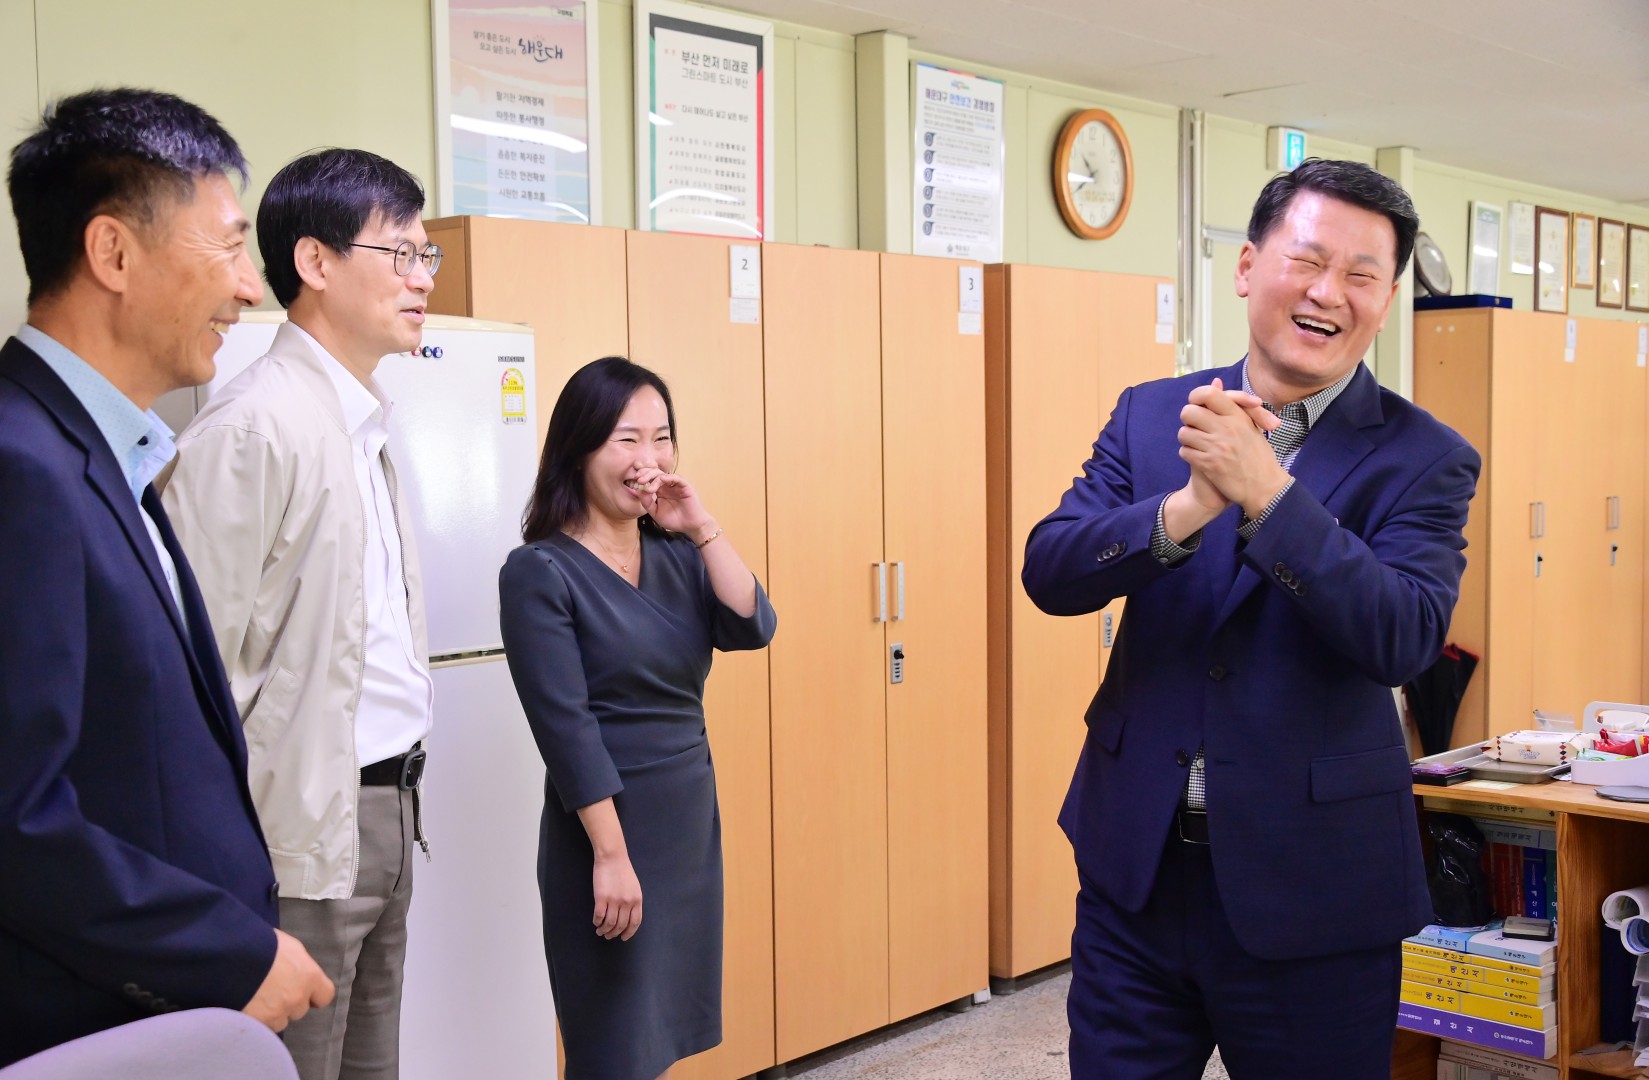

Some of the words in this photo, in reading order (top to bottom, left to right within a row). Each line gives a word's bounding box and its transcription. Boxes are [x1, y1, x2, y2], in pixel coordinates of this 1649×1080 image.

[518, 38, 563, 63] 해운대
[681, 50, 700, 66] 부산
[703, 54, 720, 70] 먼저
[723, 57, 749, 75] 미래로
[681, 67, 717, 84] 그린스마트
[719, 73, 733, 86] 도시
[734, 77, 749, 89] 부산
[741, 258, 749, 270] 2
[968, 277, 974, 291] 3
[1450, 965, 1480, 978] 예산서
[1437, 977, 1462, 988] 예산서
[1425, 991, 1455, 1004] 예산서
